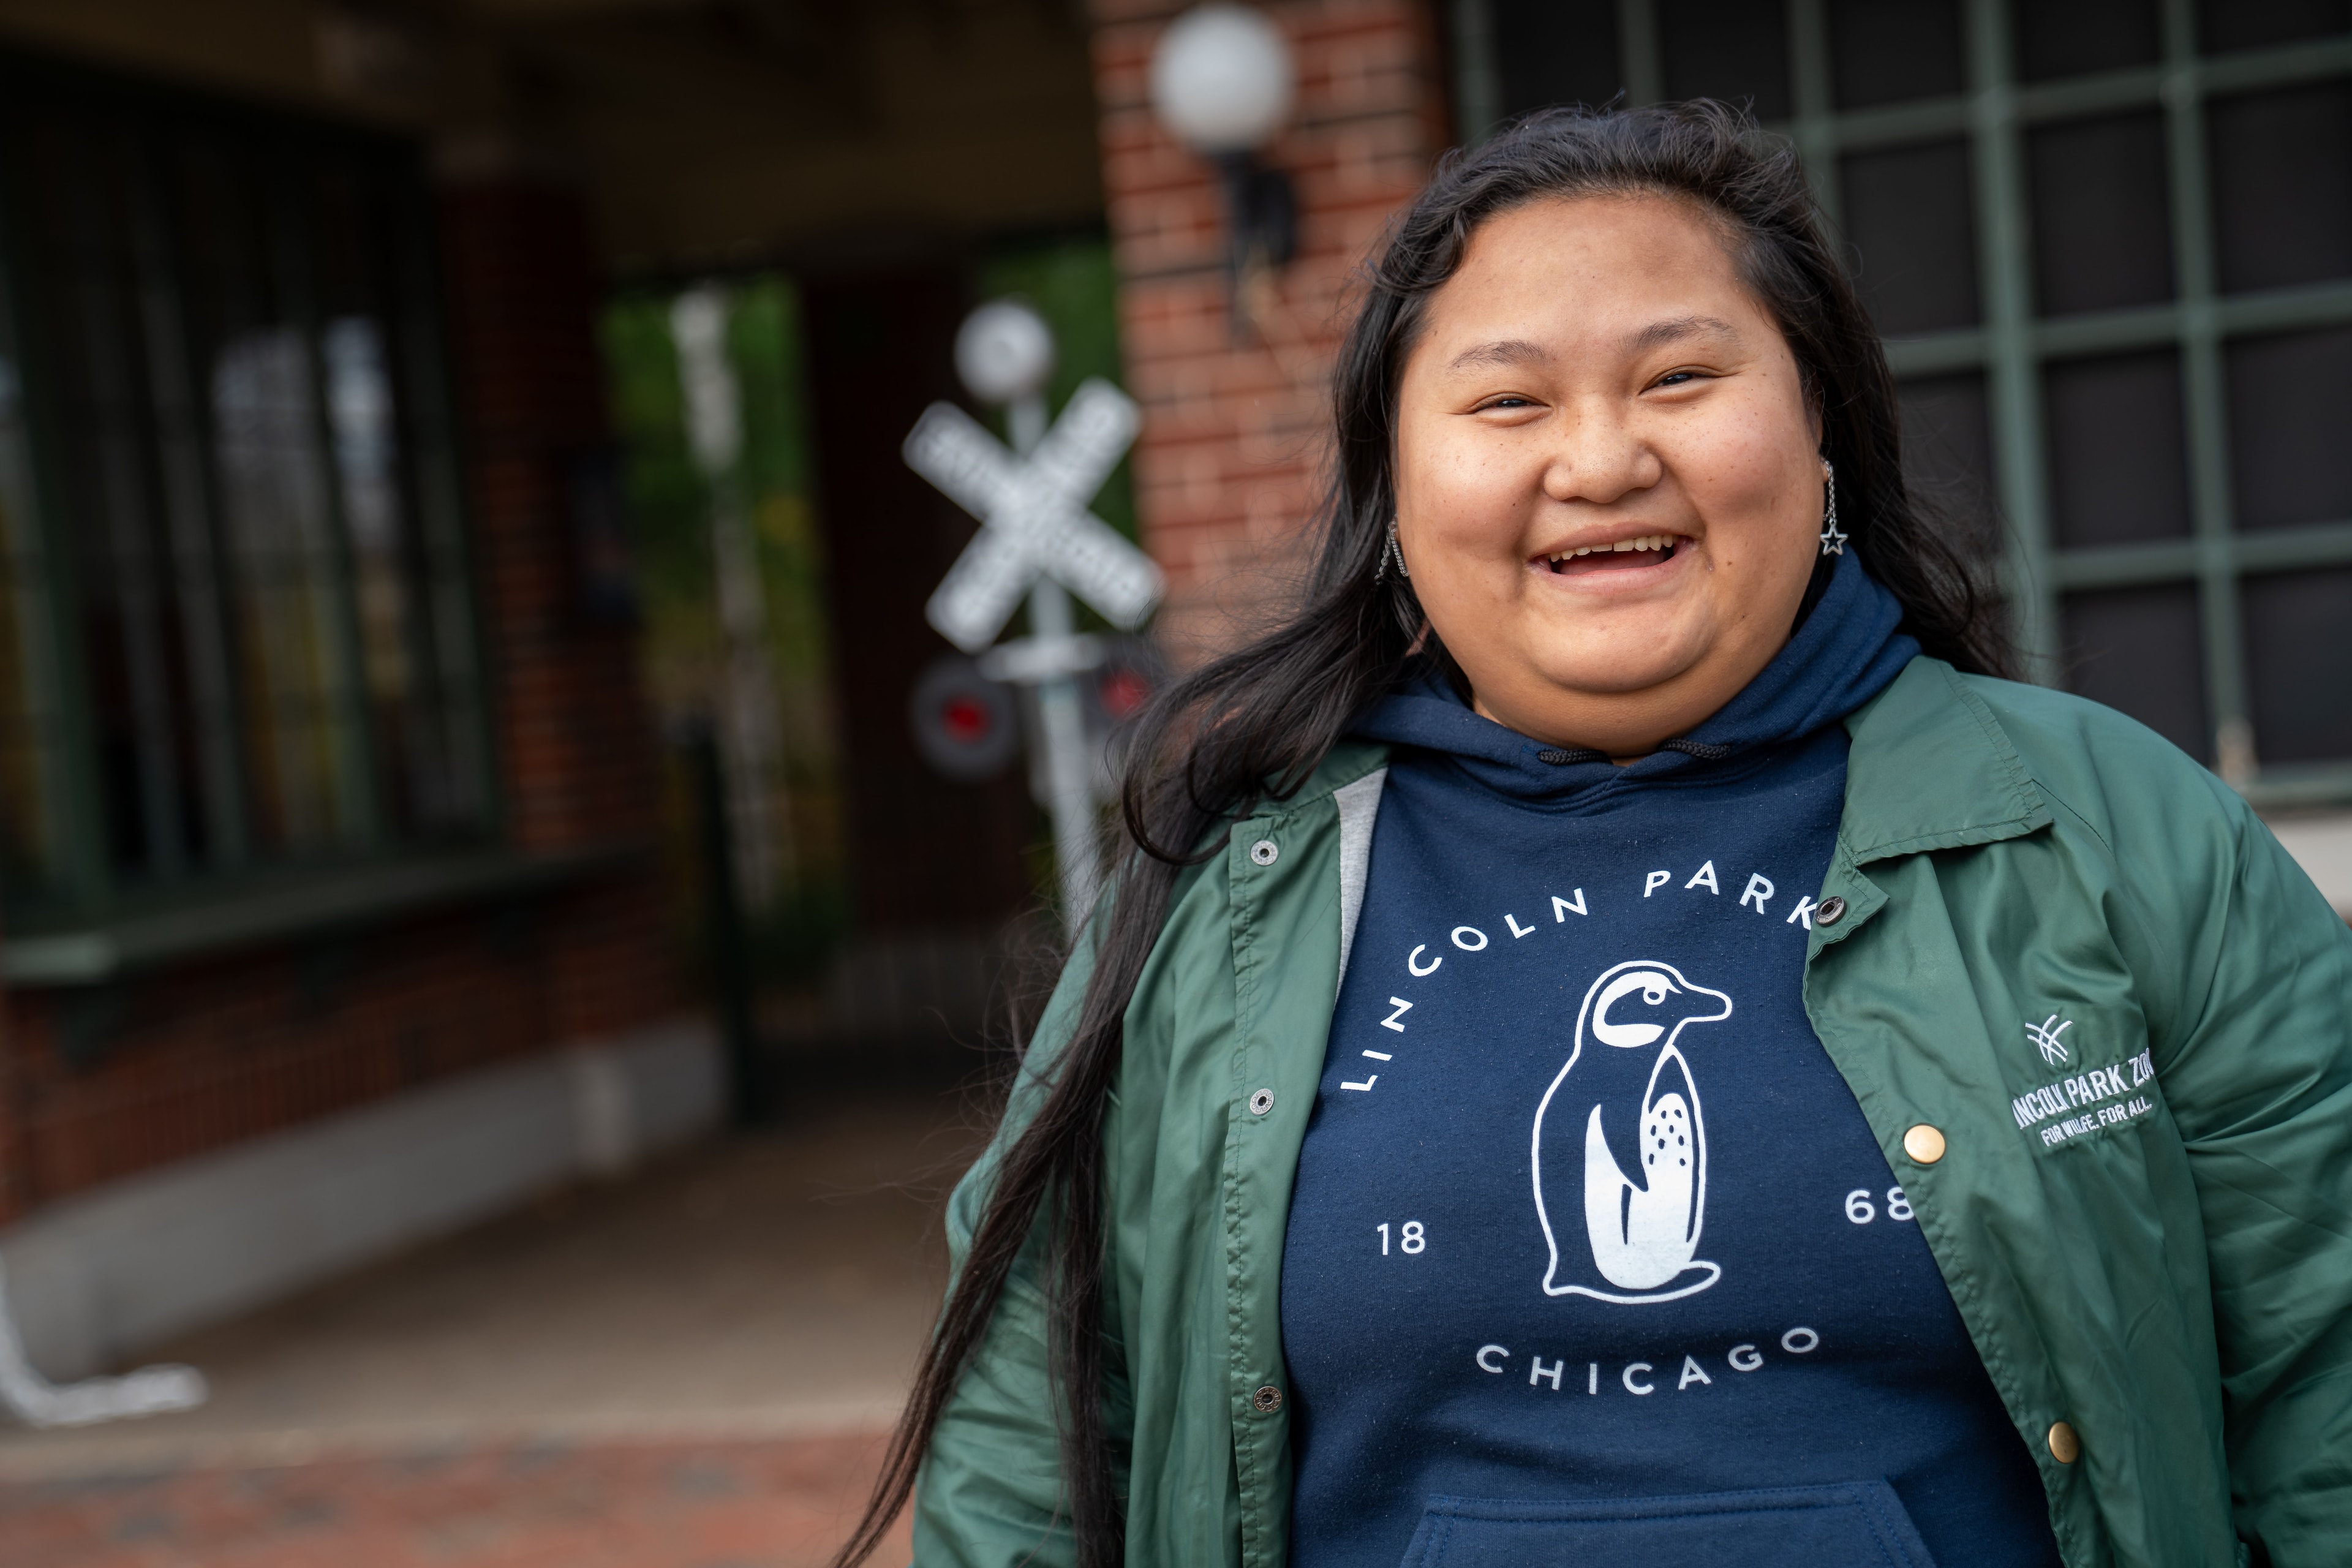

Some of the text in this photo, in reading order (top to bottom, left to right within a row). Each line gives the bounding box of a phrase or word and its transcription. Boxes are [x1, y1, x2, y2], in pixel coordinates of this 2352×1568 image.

[1340, 859, 1818, 1092] LINCOLN PARK
[2010, 1083, 2071, 1130] INCOLN
[2064, 1064, 2130, 1107] PARK
[2040, 1125, 2066, 1147] FOR
[2097, 1104, 2128, 1126] FOR
[2128, 1096, 2153, 1117] ALL.
[1377, 1186, 1915, 1256] 18 68
[1476, 1327, 1819, 1395] CHICAGO
